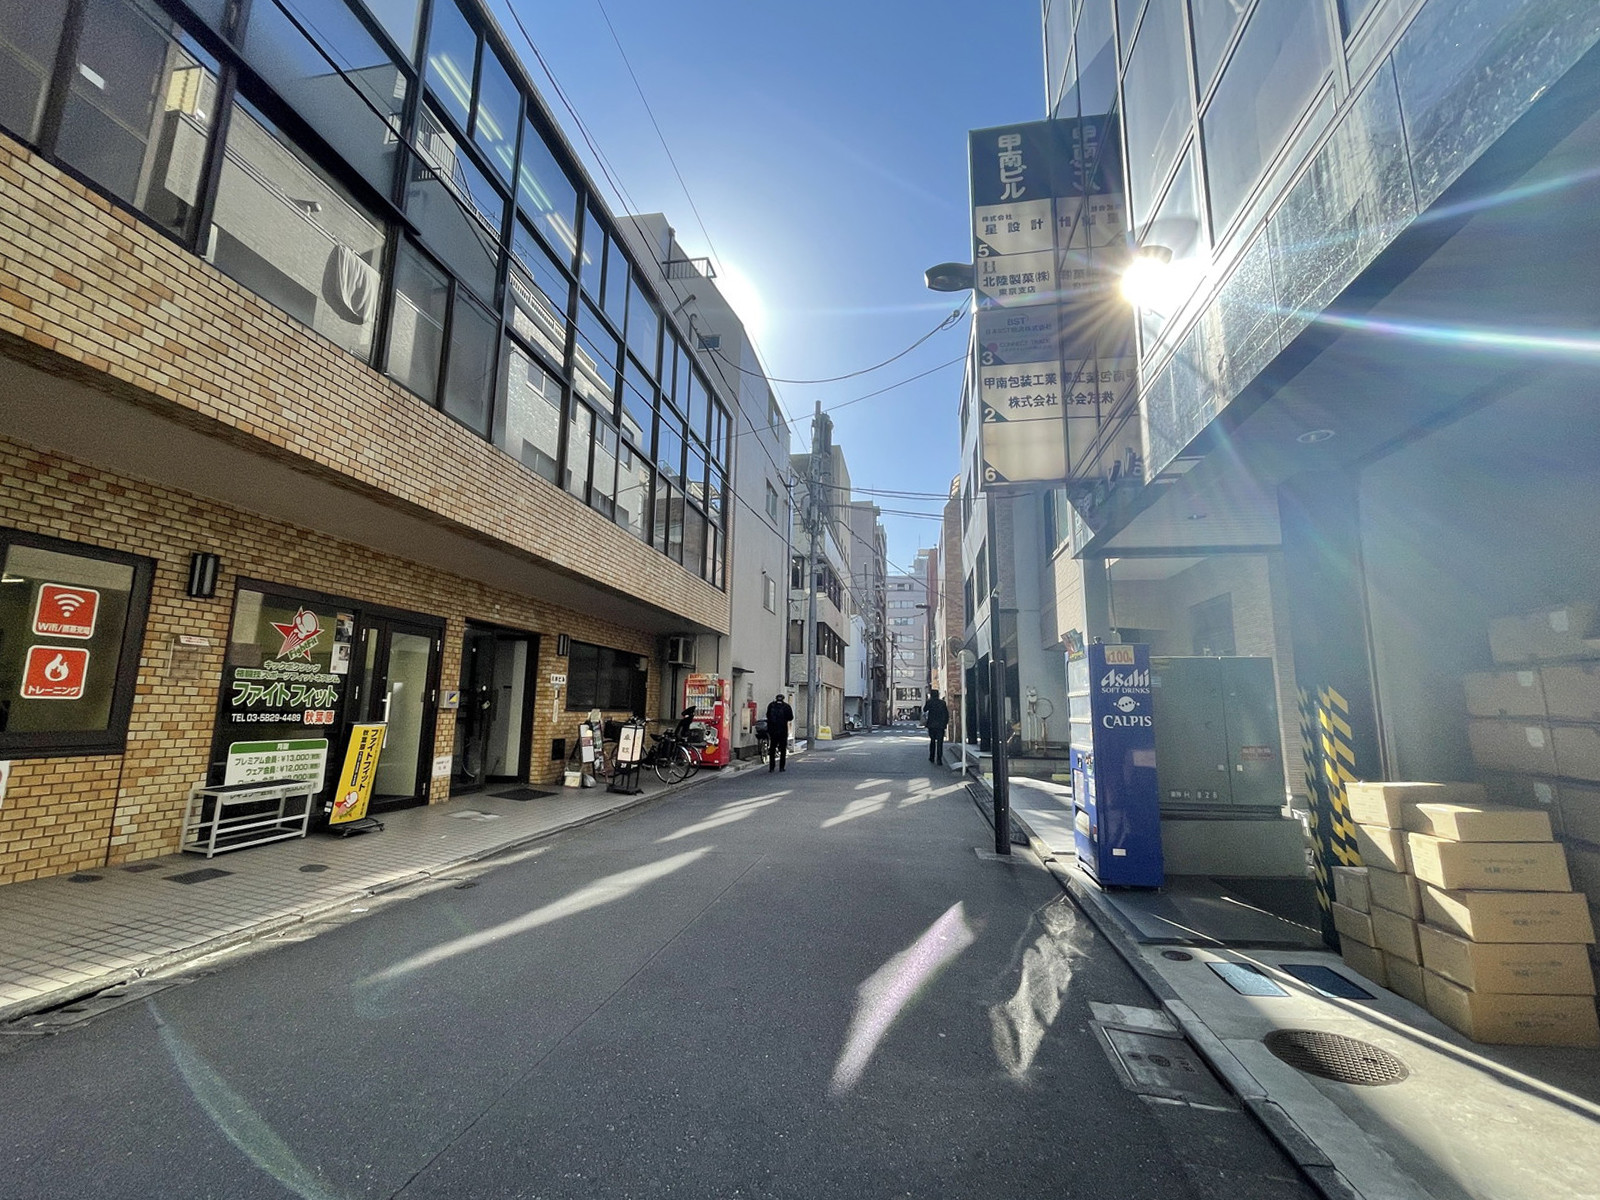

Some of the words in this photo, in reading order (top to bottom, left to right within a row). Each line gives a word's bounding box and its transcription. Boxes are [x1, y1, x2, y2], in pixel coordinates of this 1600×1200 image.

[998, 133, 1027, 200] 甲南ビル
[982, 214, 1013, 222] 株式会社
[978, 244, 990, 257] 5
[983, 270, 1050, 287] 北陸製菓(株)
[999, 286, 1036, 296] 東京支店
[981, 351, 994, 365] 3
[984, 372, 1057, 389] 甲南包装工業
[1008, 393, 1058, 409] 株式会社
[984, 408, 996, 422] 2
[985, 467, 996, 481] 6
[1101, 668, 1150, 687] Asahi
[28, 685, 80, 695] トレーニング
[232, 681, 338, 707] ファイトフィット
[232, 713, 245, 722] TEL
[1103, 715, 1152, 729] CALPIS
[359, 729, 379, 791] ファイトフィット
